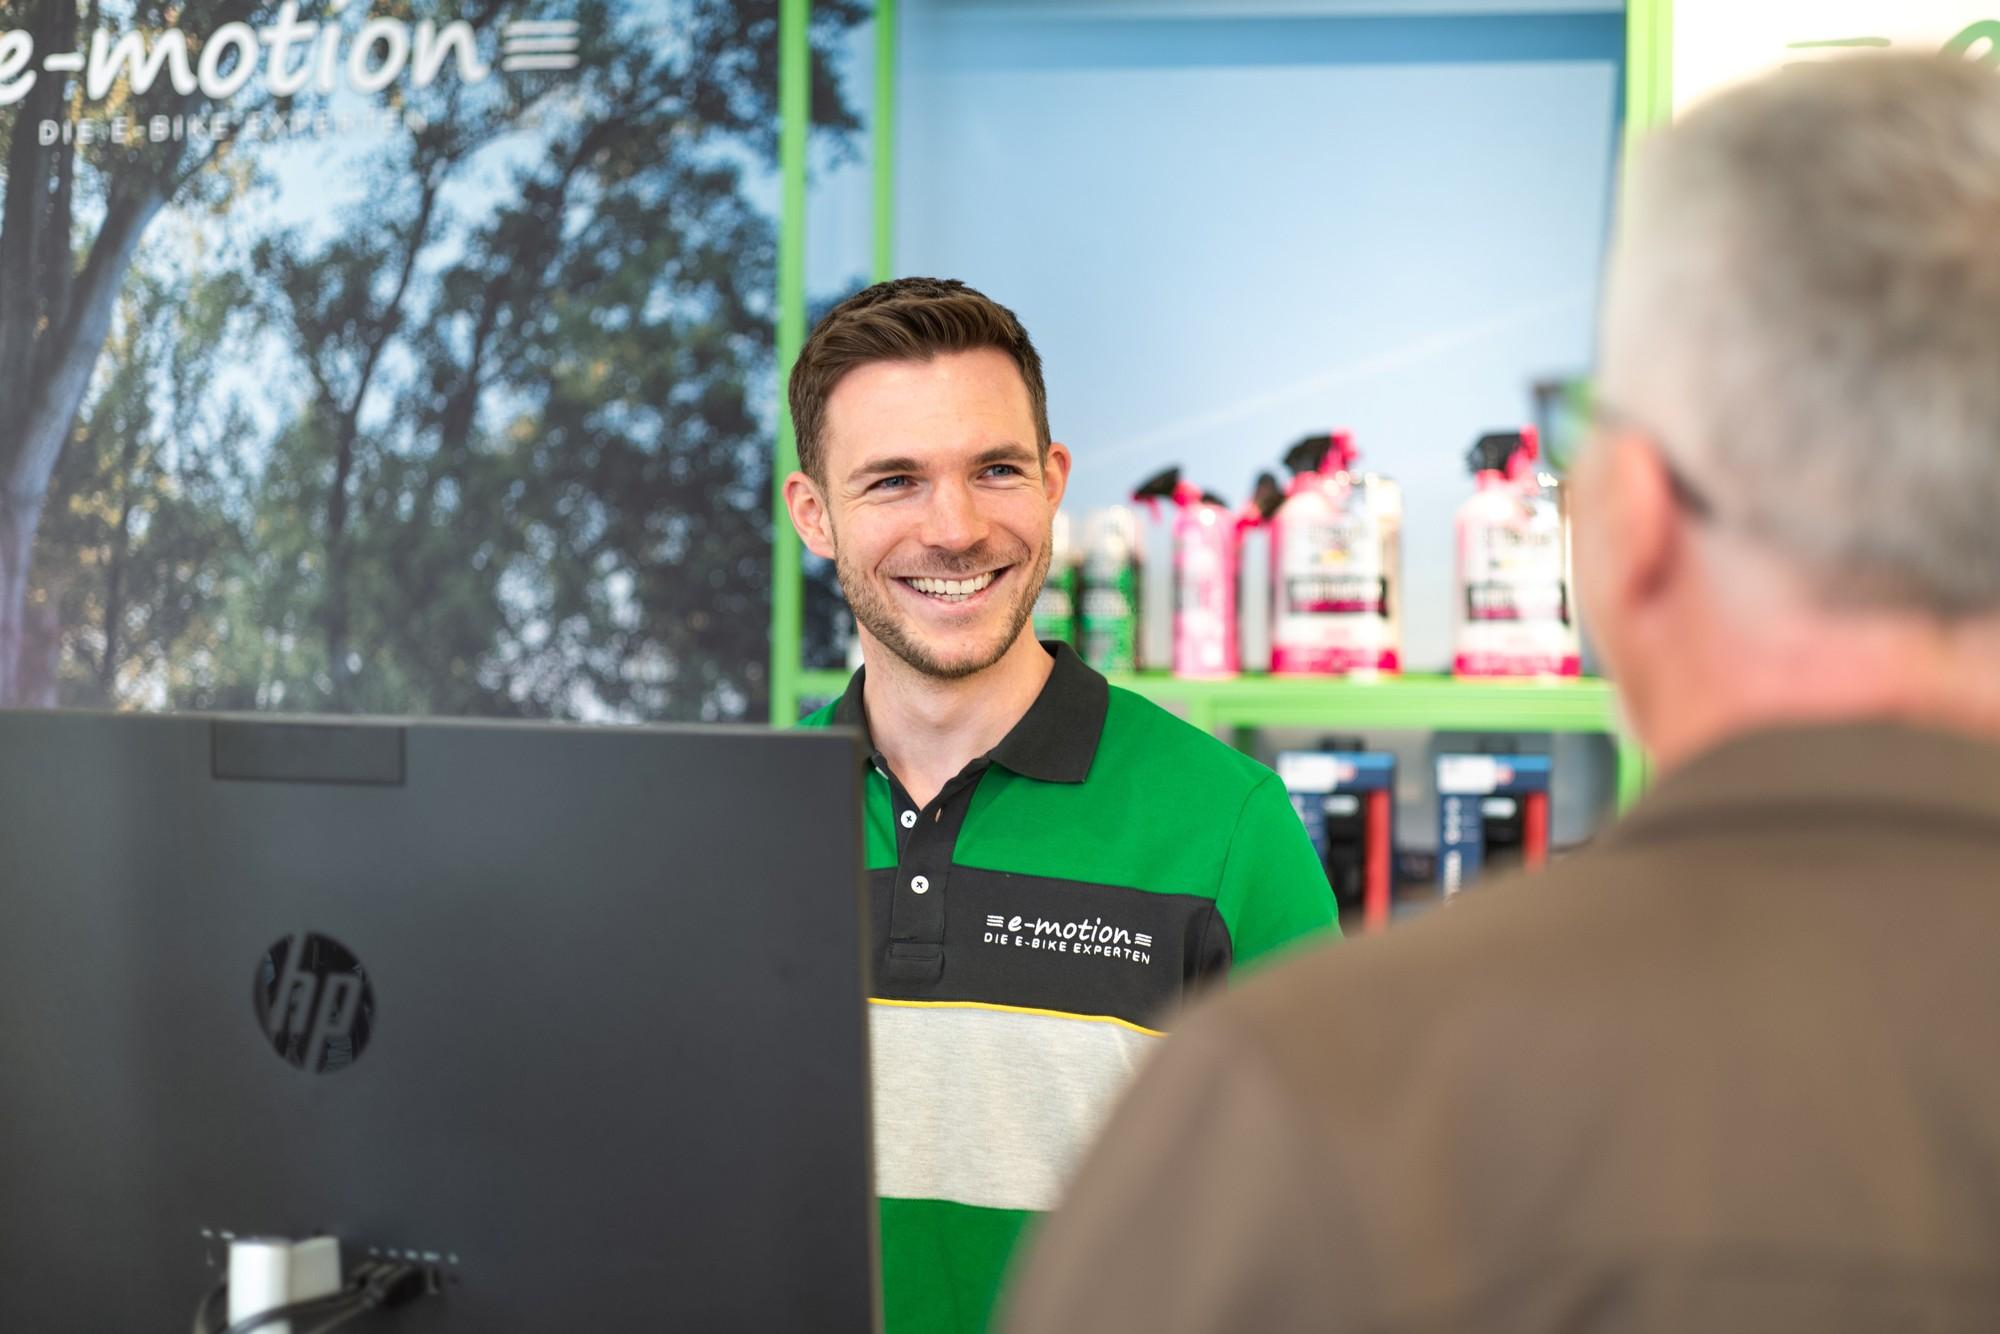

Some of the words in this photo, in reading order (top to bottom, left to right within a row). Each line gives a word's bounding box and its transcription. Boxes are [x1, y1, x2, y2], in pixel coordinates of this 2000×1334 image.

[0, 0, 490, 103] e-motion
[38, 118, 94, 146] DIE
[110, 113, 230, 144] E-BIKE
[1008, 915, 1132, 944] e-motion
[984, 932, 1009, 945] DIE
[1015, 935, 1067, 952] E-BIKE
[1073, 943, 1151, 965] EXPERTEN
[268, 931, 363, 1073] hp
